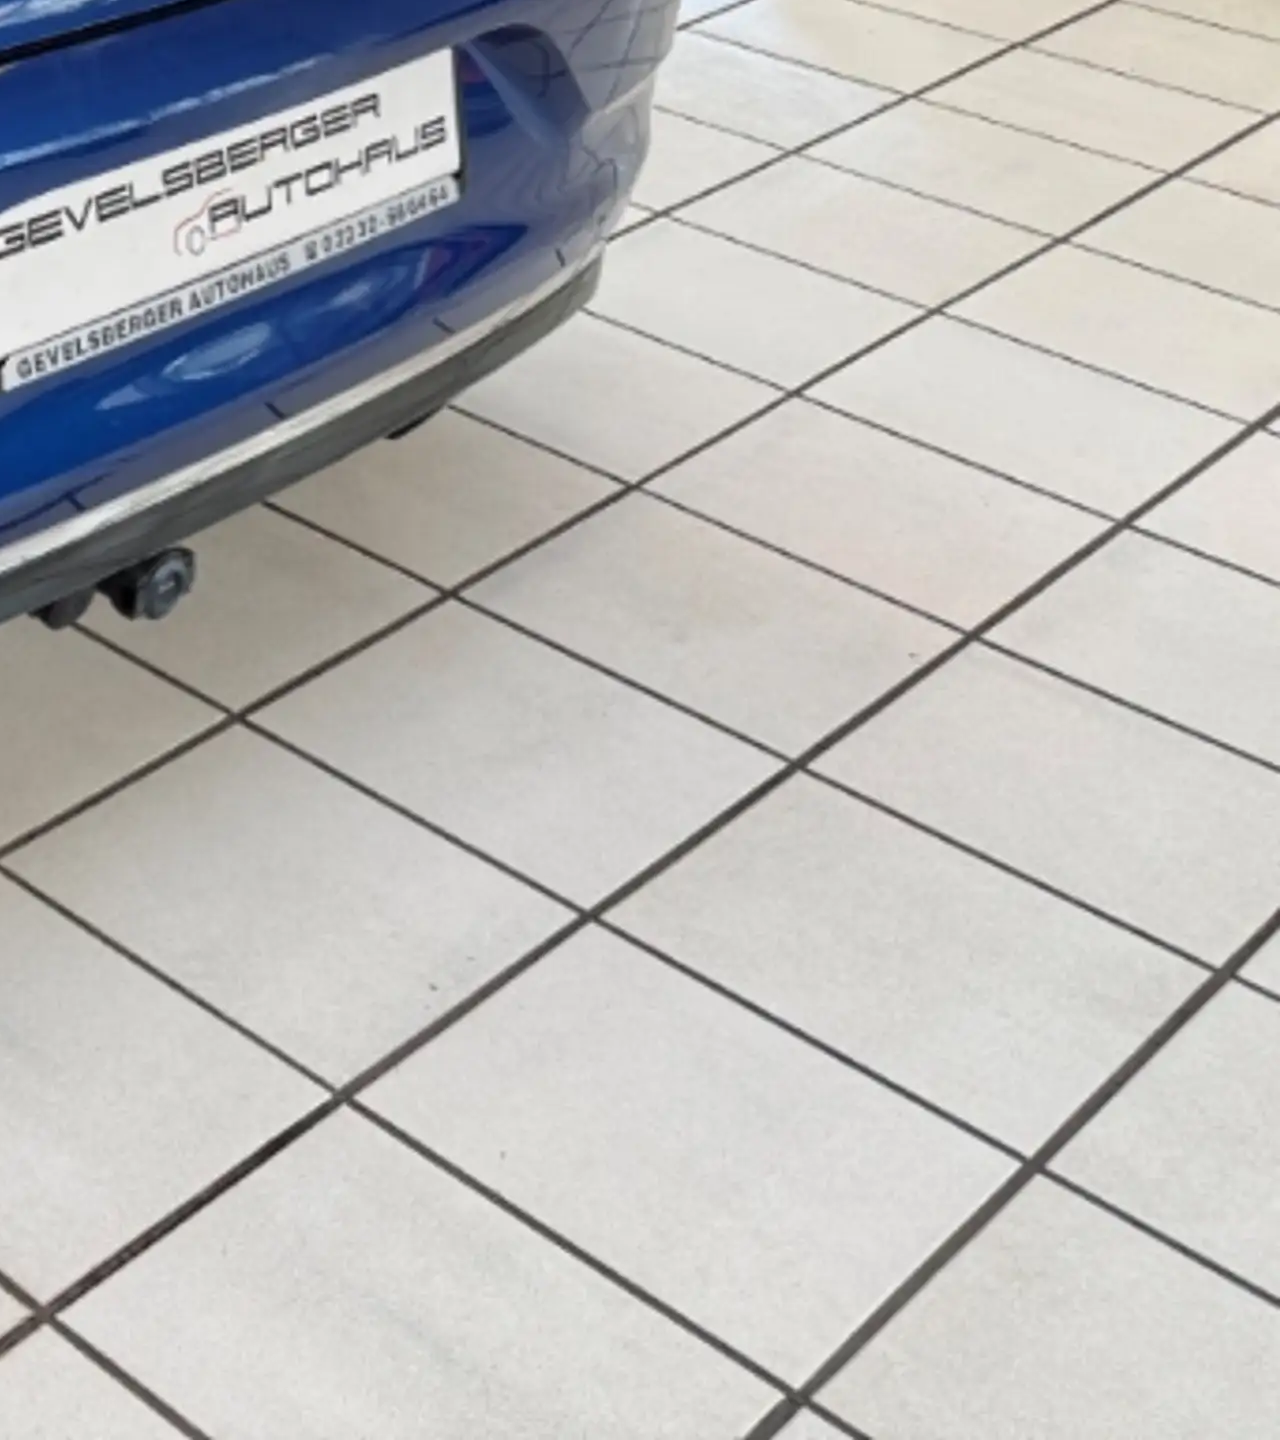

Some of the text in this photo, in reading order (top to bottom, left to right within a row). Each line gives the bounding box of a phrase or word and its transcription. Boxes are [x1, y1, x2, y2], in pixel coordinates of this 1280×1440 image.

[208, 116, 447, 236] AUTOHAUS
[15, 297, 184, 380] GEVELSBERGER
[189, 251, 291, 311] AUTOHAUS
